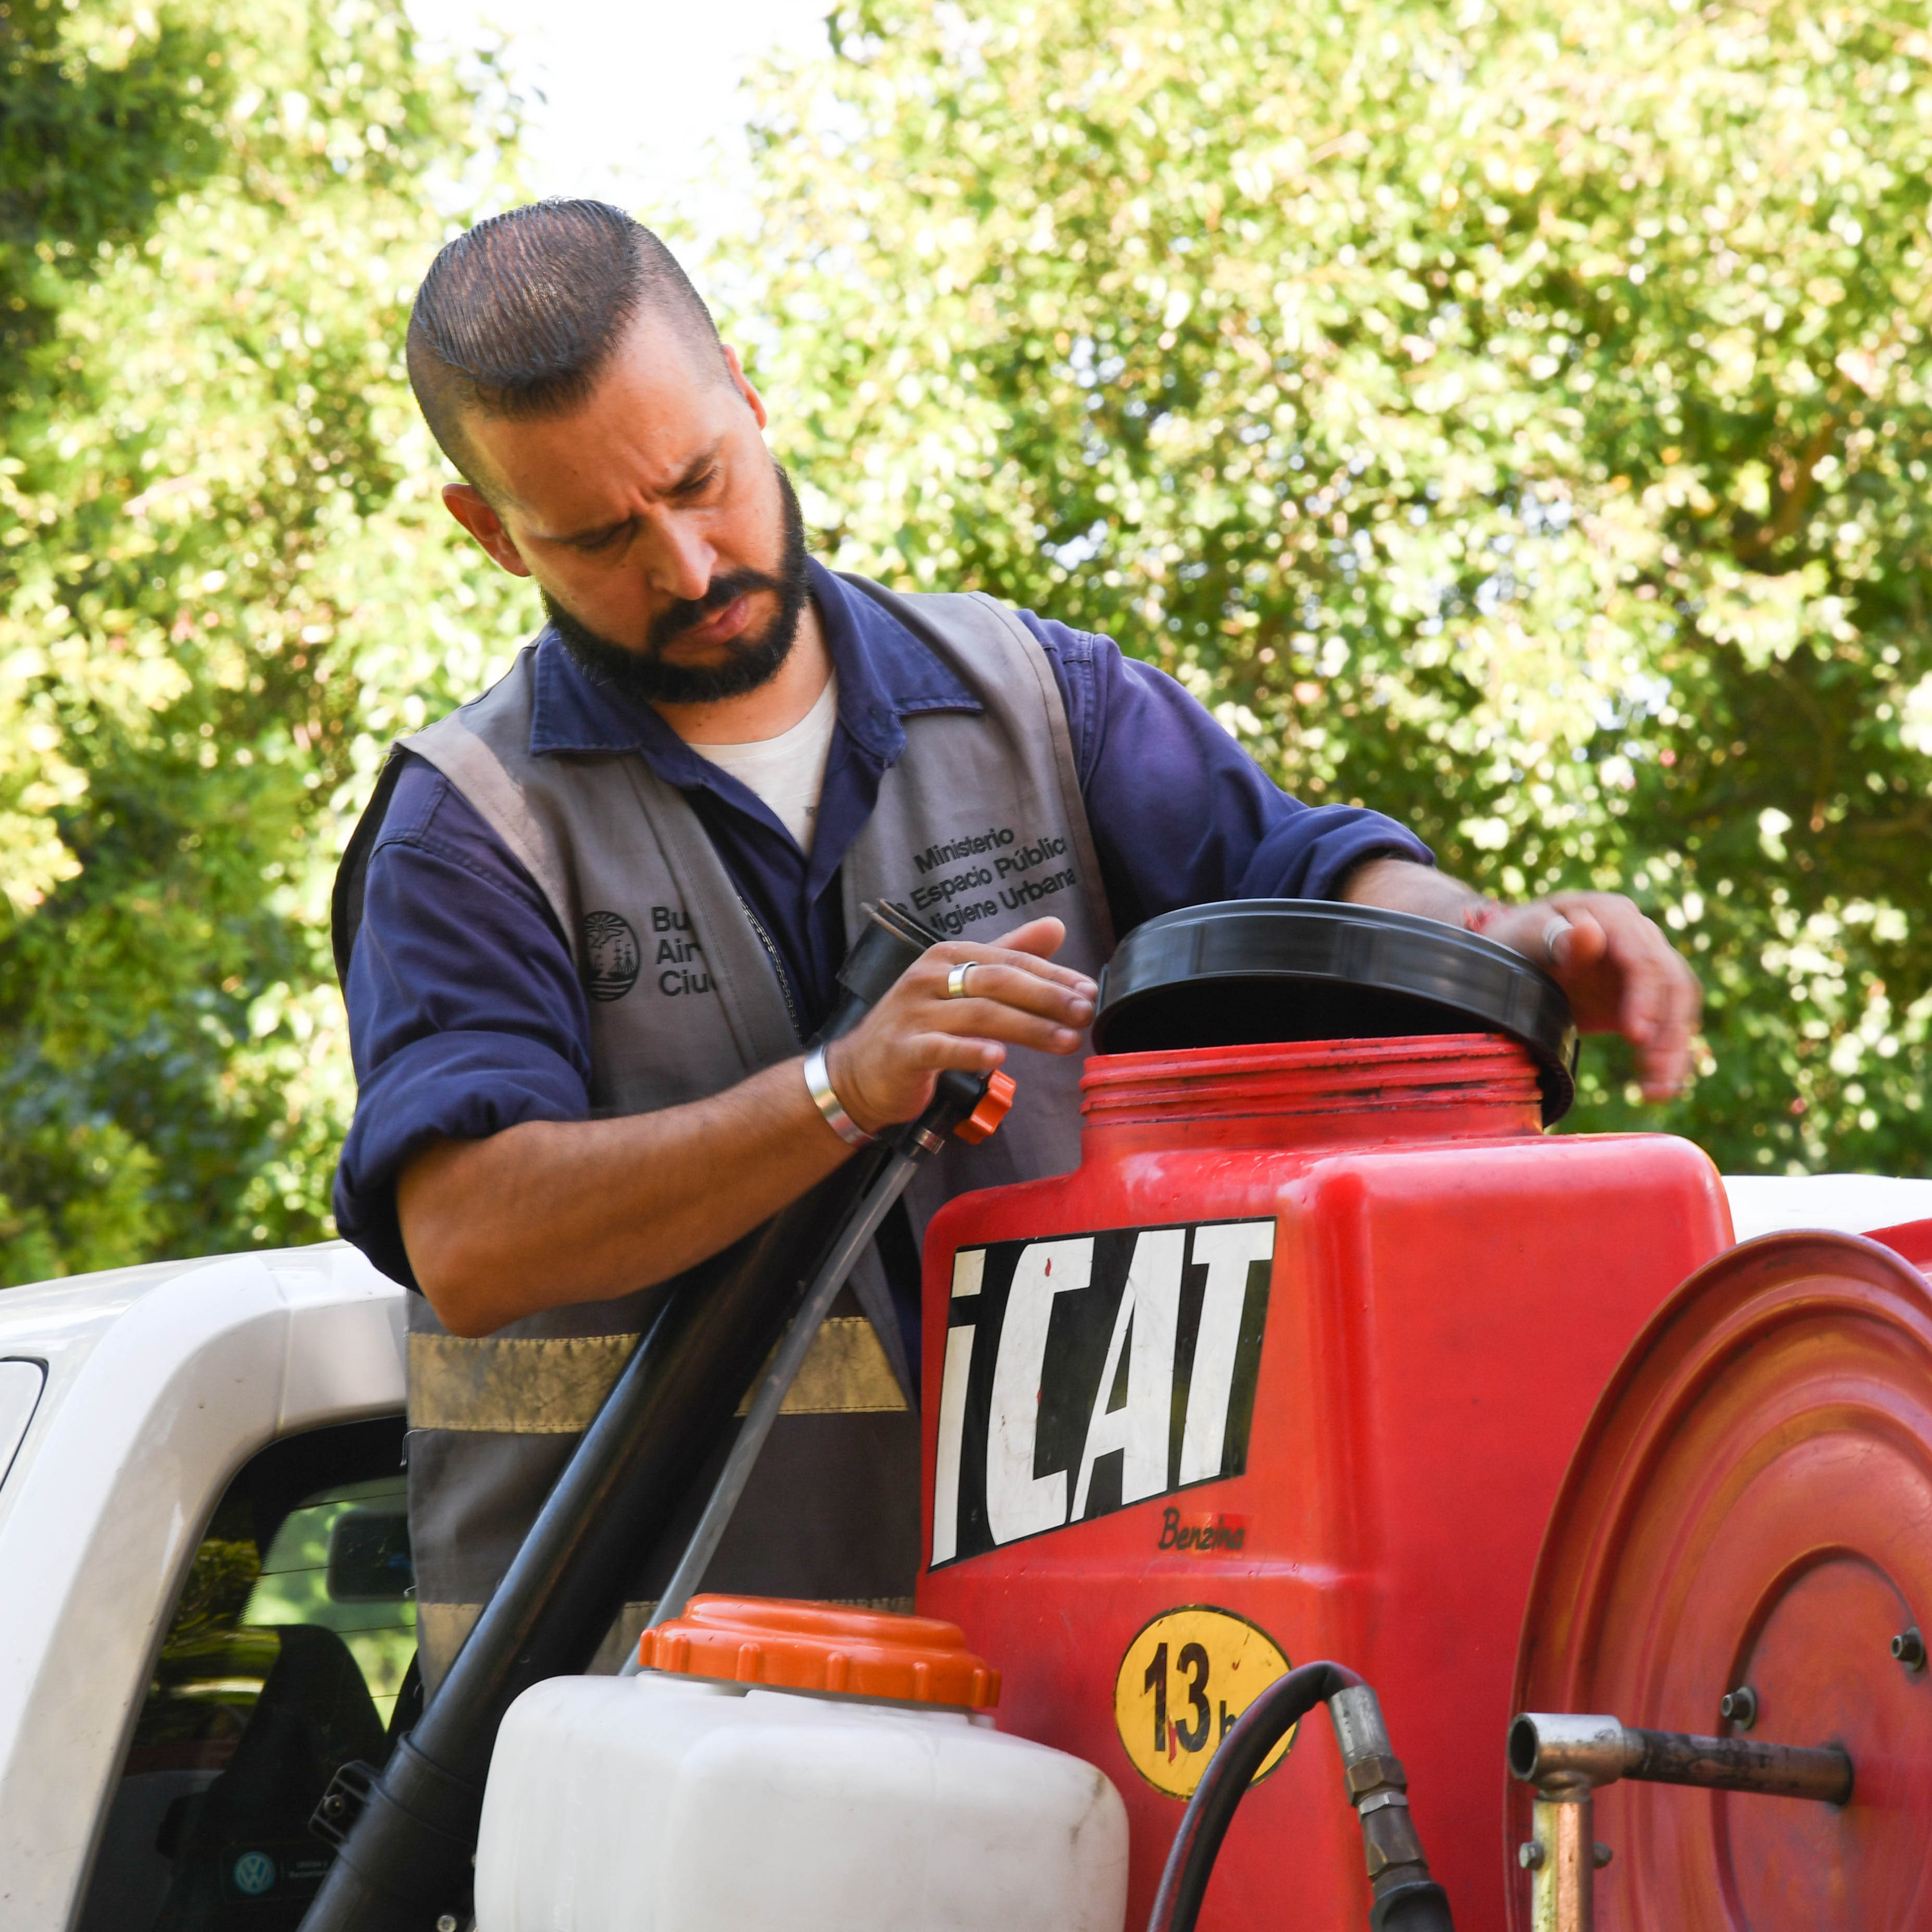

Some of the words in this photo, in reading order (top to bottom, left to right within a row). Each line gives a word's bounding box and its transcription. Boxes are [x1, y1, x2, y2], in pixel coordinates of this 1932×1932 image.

[913, 828, 1014, 874] Ministerio
[909, 866, 992, 911] Espacio
[658, 969, 717, 996] Ciu
[931, 1221, 1276, 1567] iCAT
[1159, 1507, 1245, 1550] Benzina
[1144, 1642, 1211, 1753] 13
